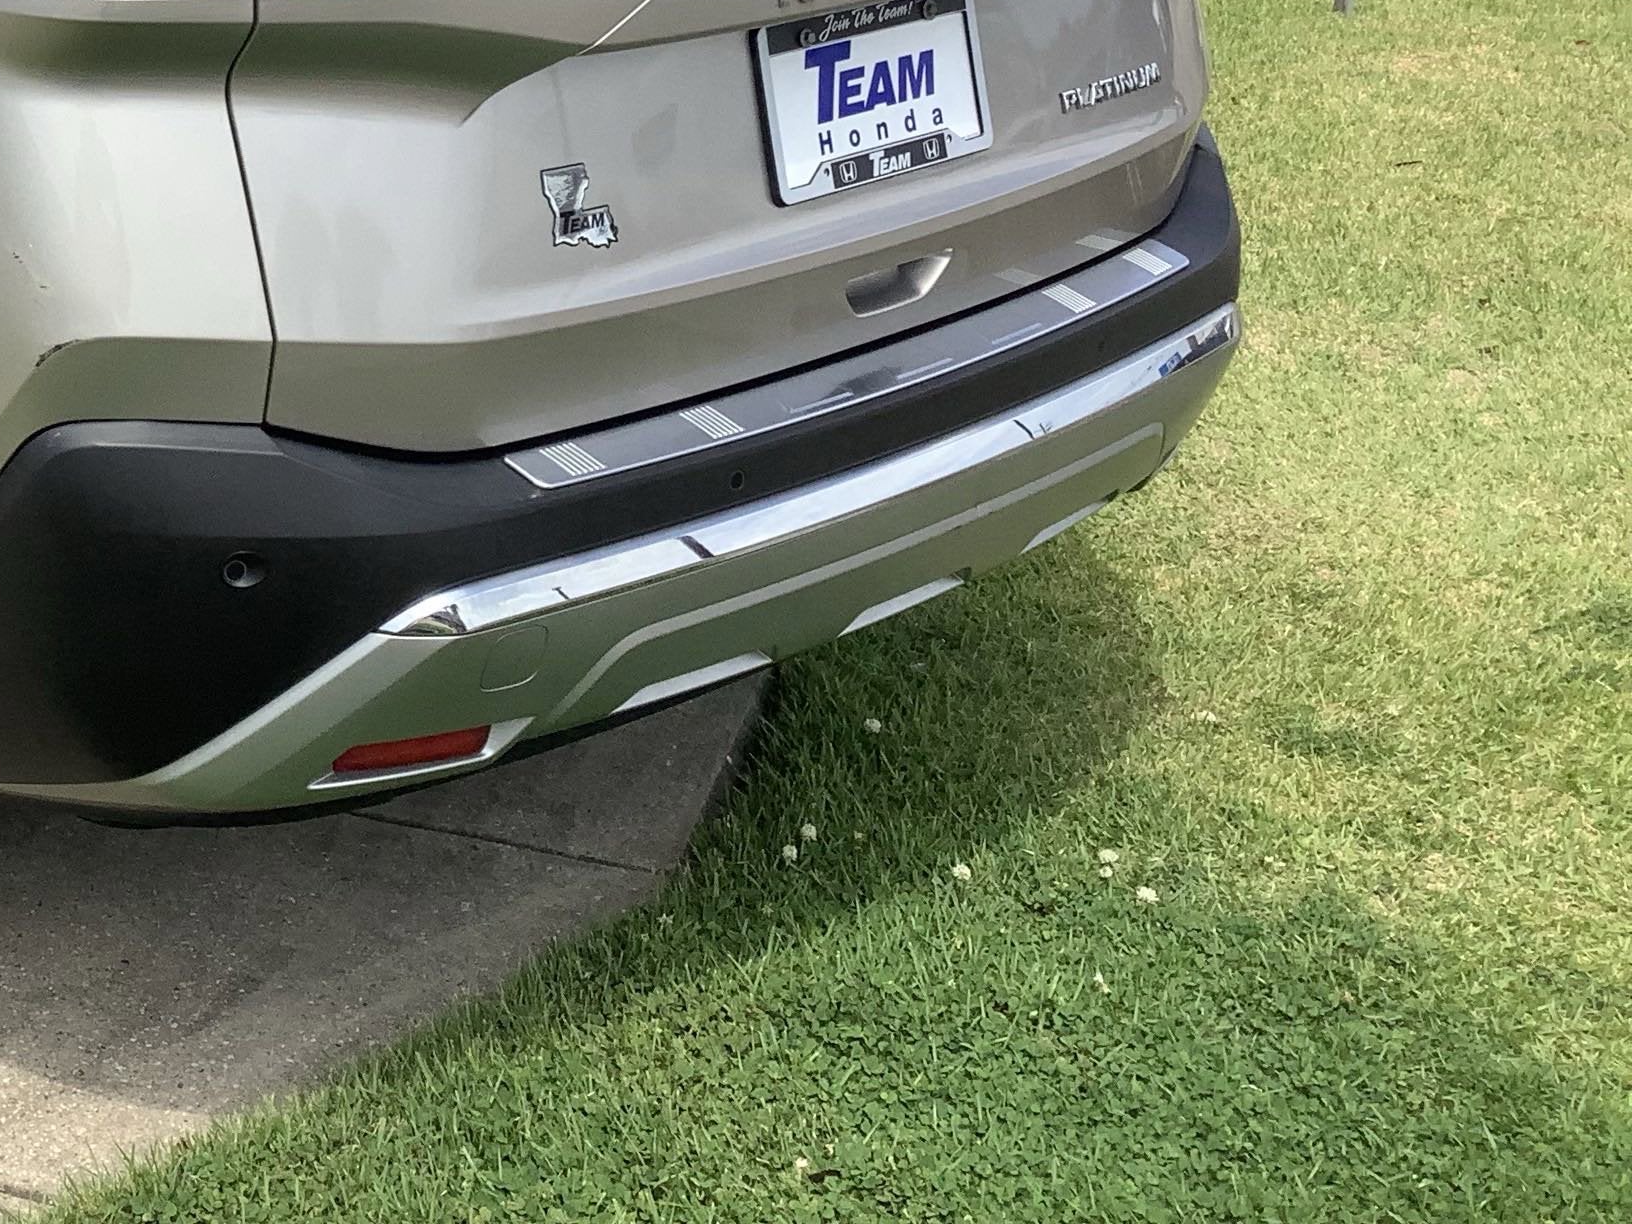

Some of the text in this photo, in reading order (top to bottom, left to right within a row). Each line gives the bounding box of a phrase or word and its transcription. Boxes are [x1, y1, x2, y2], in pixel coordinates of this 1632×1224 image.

[818, 0, 914, 42] Join The Team!
[804, 40, 935, 125] TEAM
[1059, 62, 1162, 114] PLATINUM
[819, 108, 944, 156] Honda
[869, 150, 911, 178] TEAM
[559, 211, 605, 235] TEAM
